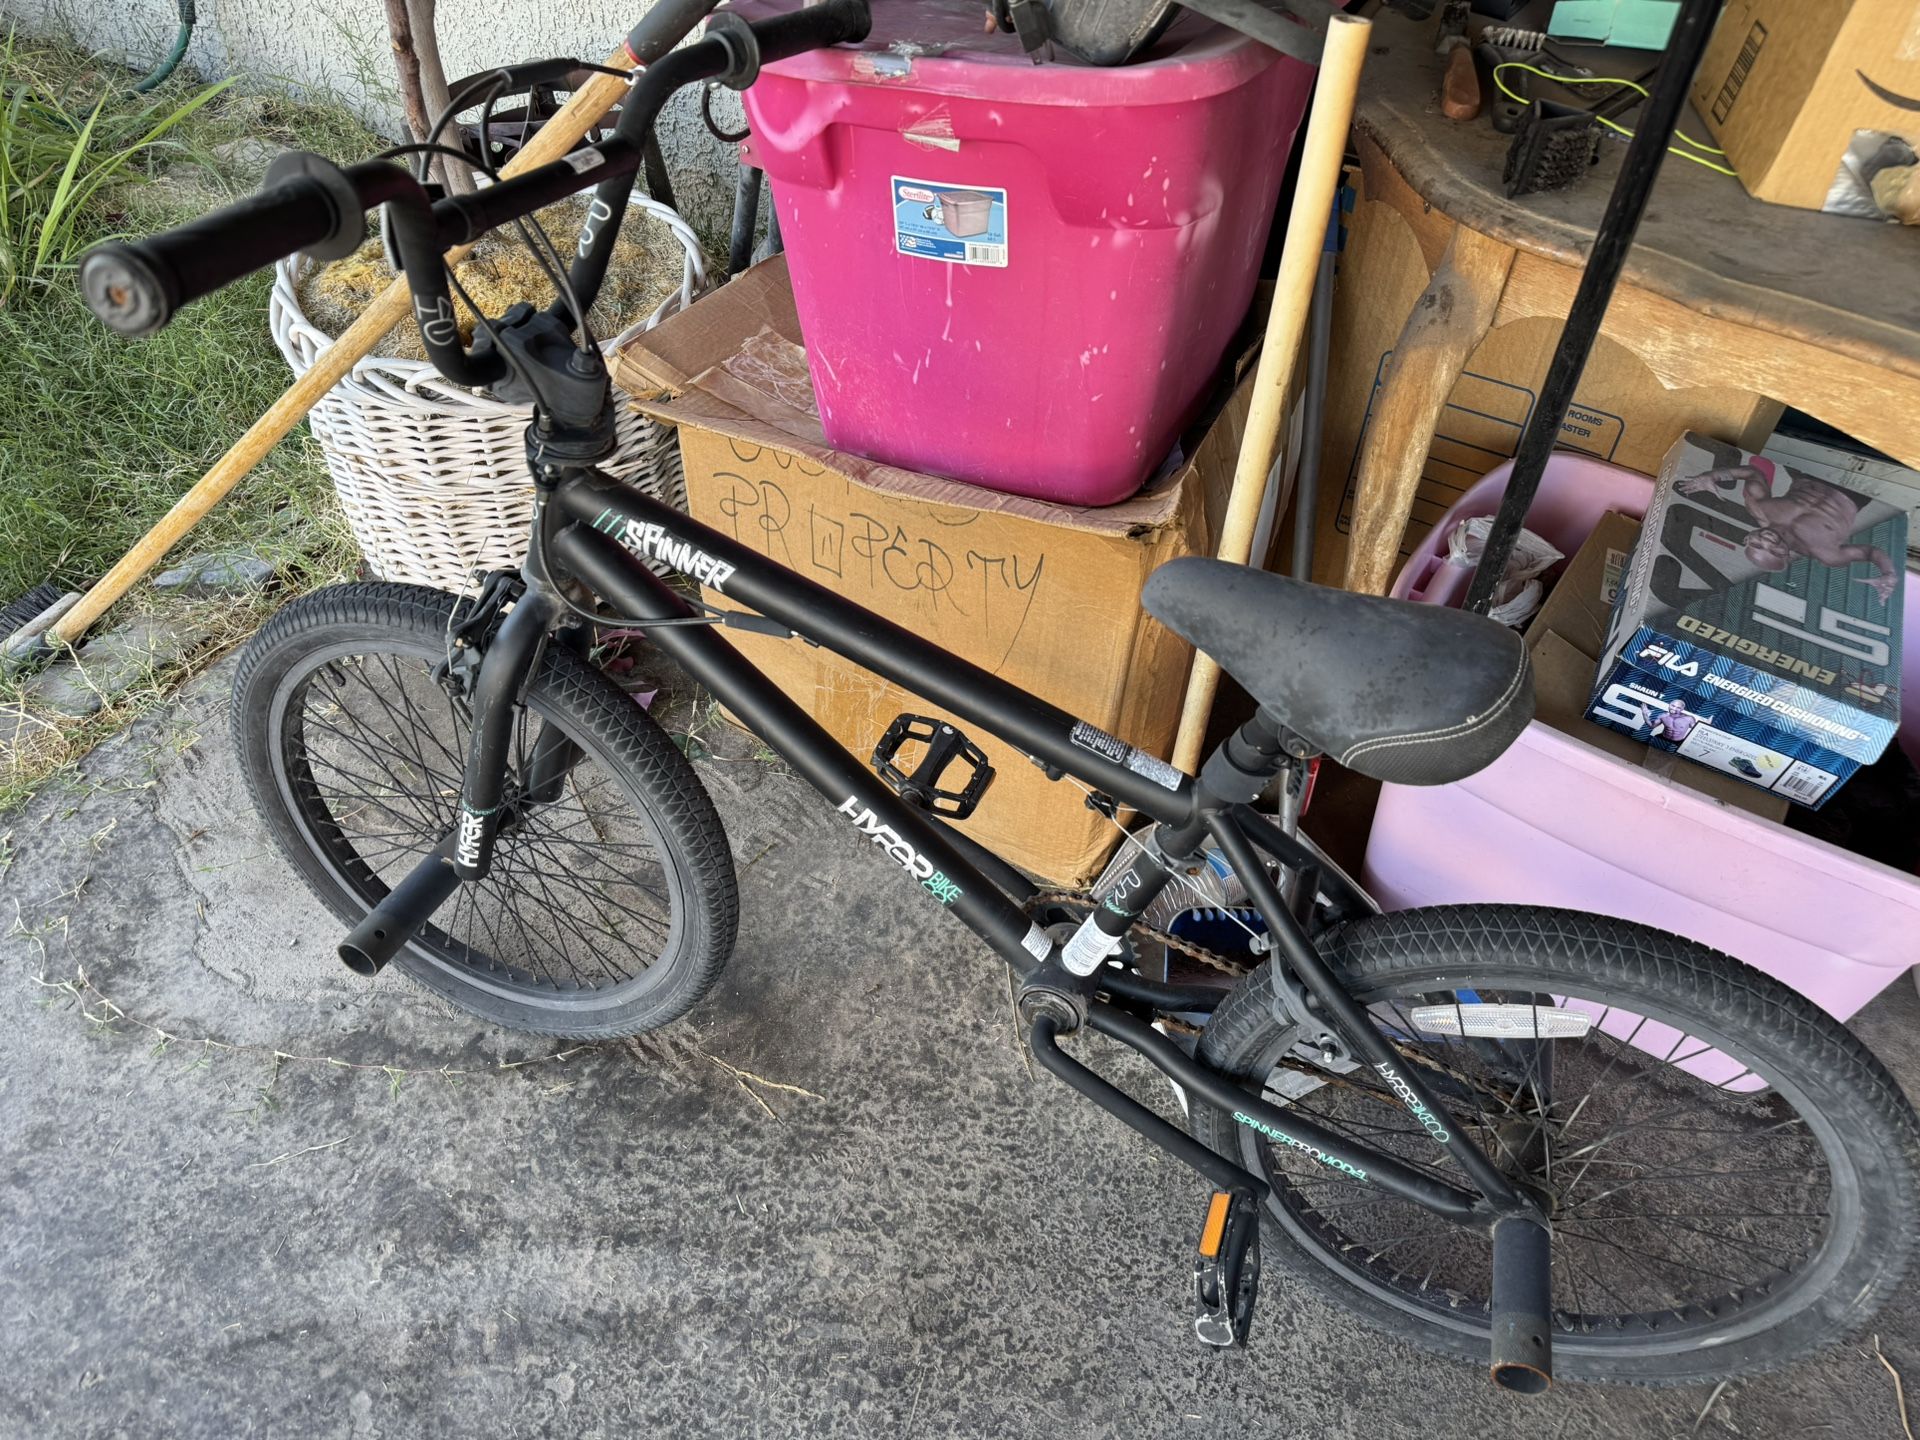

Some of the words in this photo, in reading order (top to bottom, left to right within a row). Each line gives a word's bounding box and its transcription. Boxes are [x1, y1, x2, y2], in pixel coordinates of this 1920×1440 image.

[1560, 423, 1591, 437] ASTER
[1567, 410, 1604, 425] ROOMS
[624, 518, 737, 592] SPINNER
[1639, 645, 1699, 677] FILA
[1676, 615, 1837, 685] ENERGIZED
[1629, 682, 1657, 698] SHAUN
[1702, 673, 1776, 706] ENERGIZED
[457, 810, 484, 868] HYPER
[838, 795, 934, 880] HYPER
[929, 871, 963, 902] BIKE
